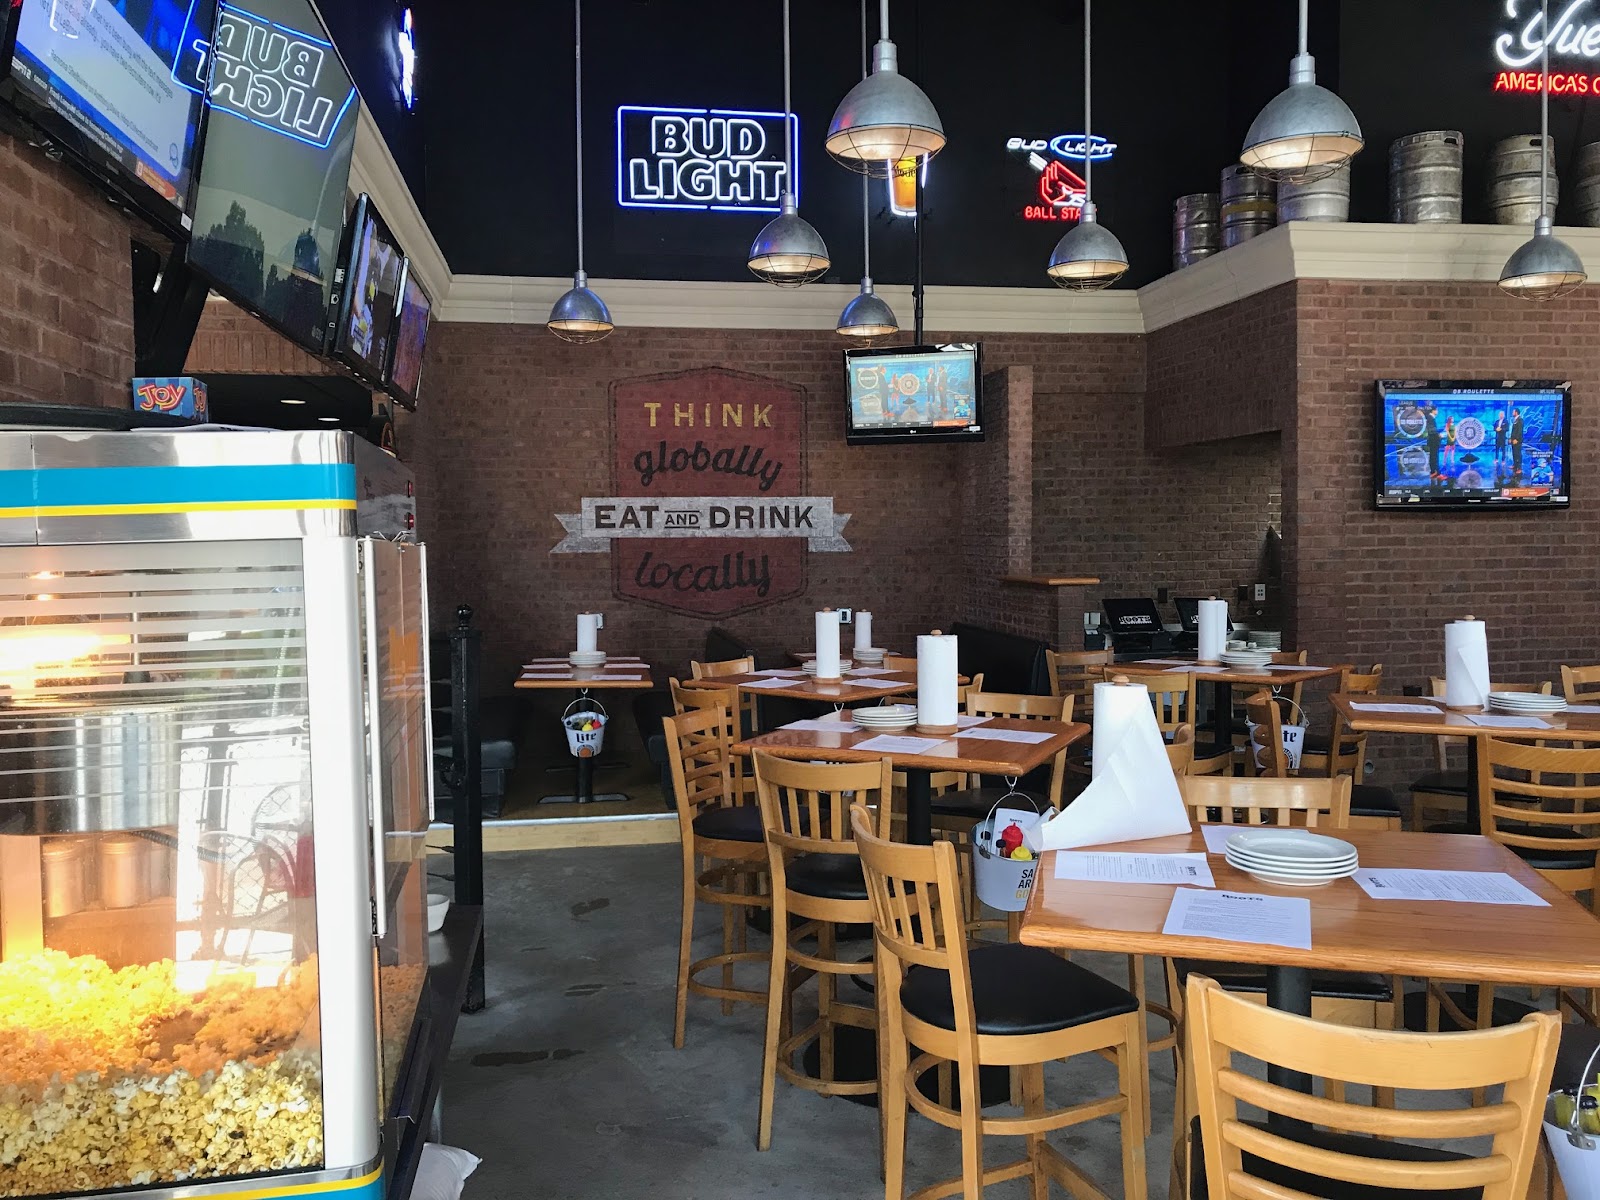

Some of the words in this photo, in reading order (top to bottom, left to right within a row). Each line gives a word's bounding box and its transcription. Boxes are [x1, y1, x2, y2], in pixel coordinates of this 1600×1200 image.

[651, 116, 766, 160] BUD
[1007, 137, 1048, 150] BUD
[629, 158, 787, 201] LIGHT
[1025, 205, 1057, 219] BALL
[1061, 206, 1083, 219] STA
[137, 383, 187, 411] JOY
[644, 402, 774, 427] THINK
[633, 440, 783, 491] globally
[594, 505, 659, 529] EAT
[665, 513, 699, 526] AND
[709, 505, 814, 529] DRINK
[634, 551, 771, 597] locally
